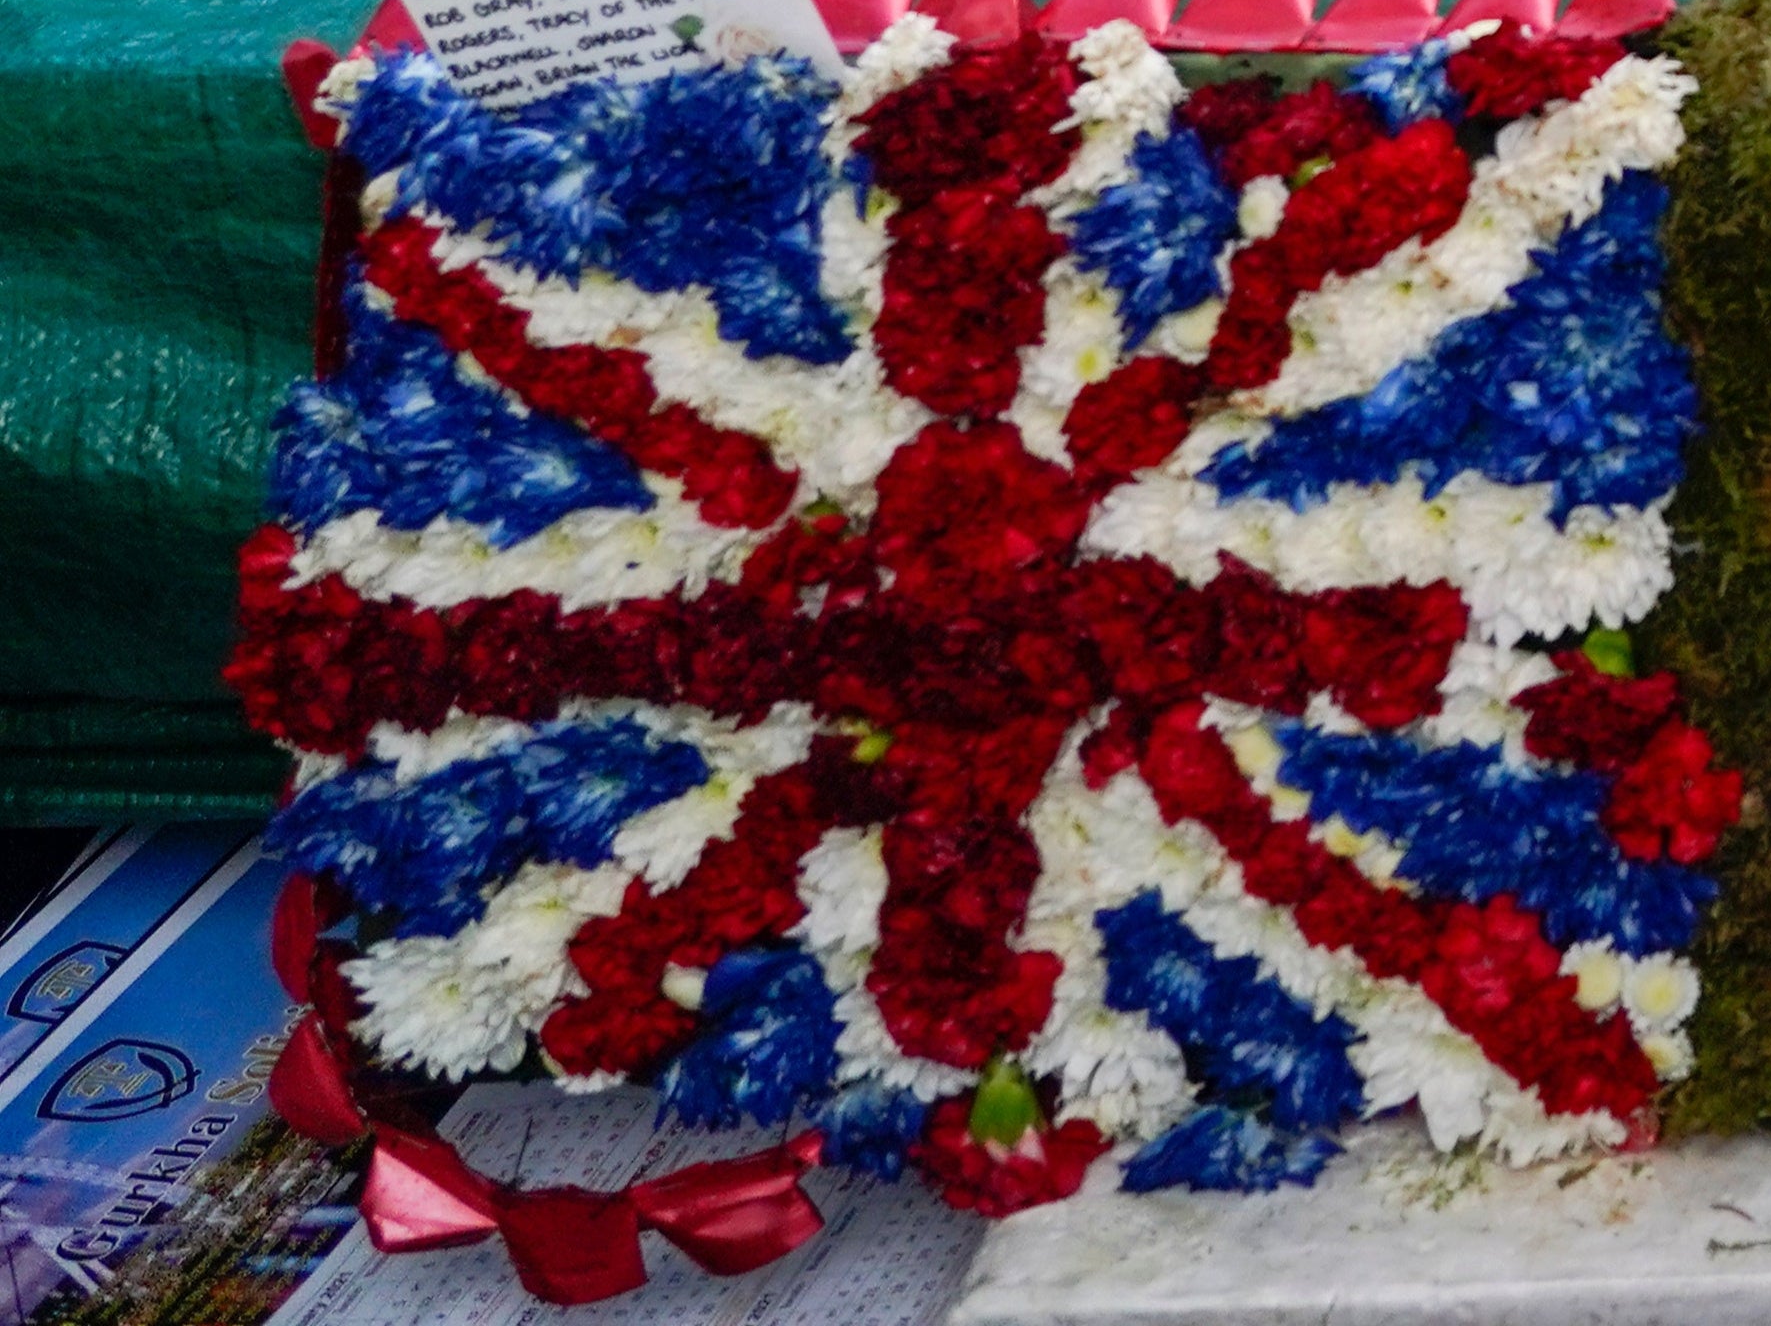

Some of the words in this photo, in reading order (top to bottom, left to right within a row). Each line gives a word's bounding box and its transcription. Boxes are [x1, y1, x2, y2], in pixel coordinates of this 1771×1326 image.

[526, 9, 590, 33] TRACY
[600, 0, 625, 18] OF
[603, 52, 645, 71] THE
